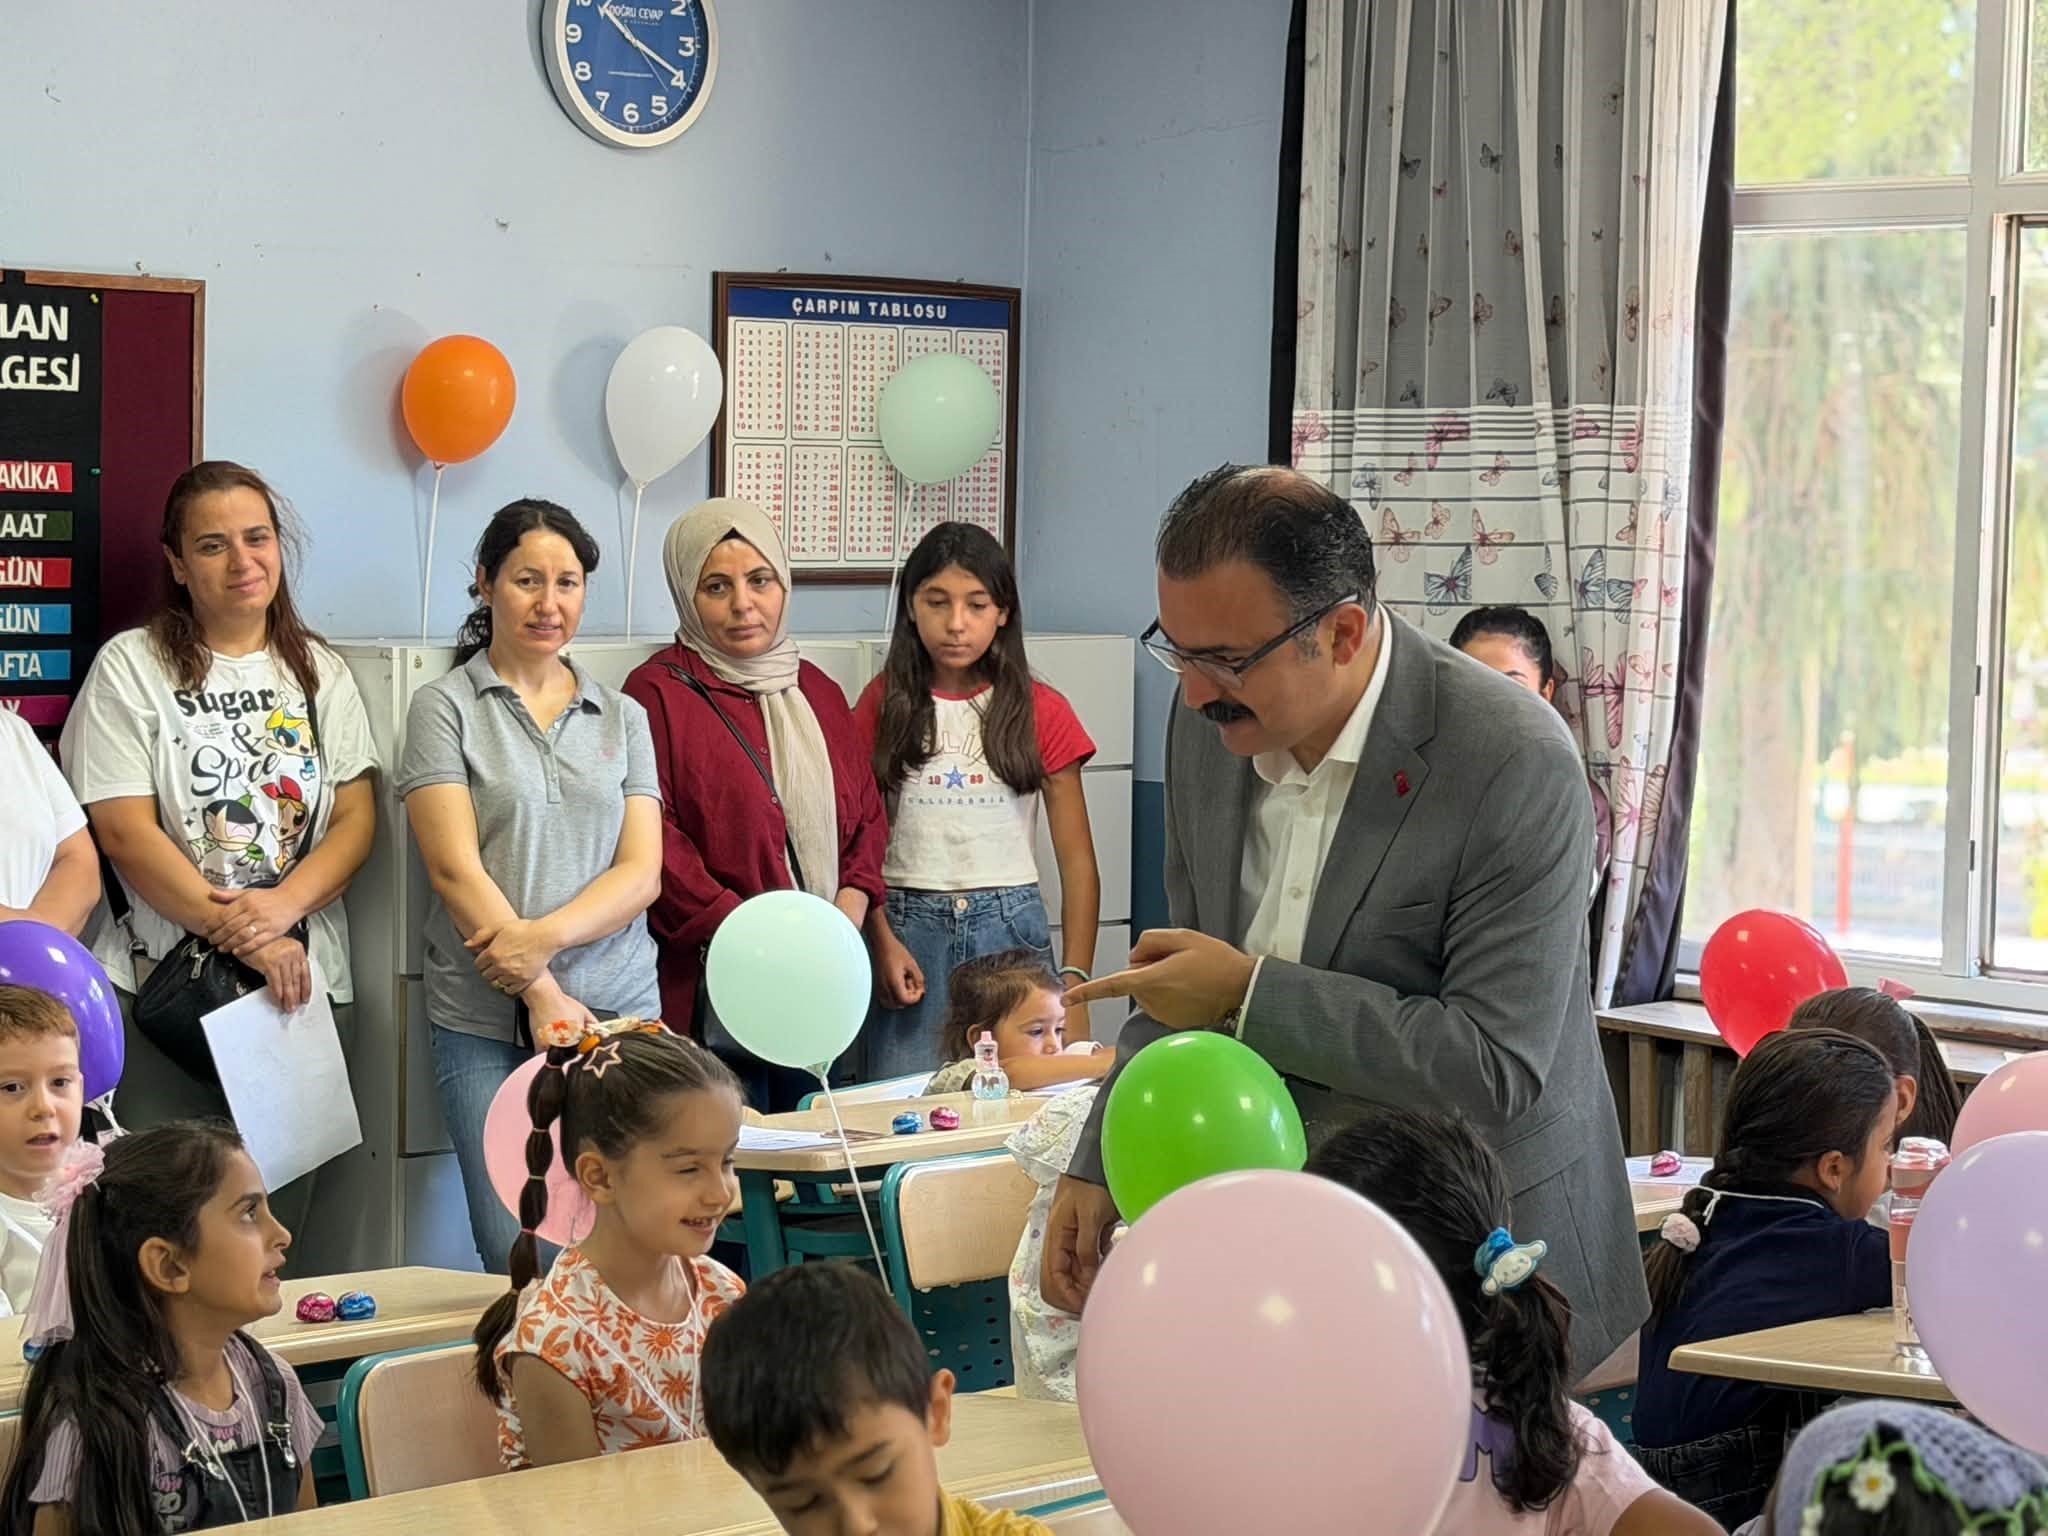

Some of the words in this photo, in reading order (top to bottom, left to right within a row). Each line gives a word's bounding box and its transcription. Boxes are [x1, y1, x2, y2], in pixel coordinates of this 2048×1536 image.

[638, 7, 664, 21] CEVAP
[565, 23, 583, 44] 9
[678, 35, 695, 58] 3
[574, 61, 592, 82] 8
[670, 69, 687, 91] 4
[595, 91, 611, 112] 7
[651, 96, 668, 116] 5
[622, 102, 640, 124] 6
[791, 297, 861, 316] ÇARPIM
[868, 301, 948, 320] TABLOSU
[0, 303, 69, 342] AN
[190, 745, 281, 798] Spice
